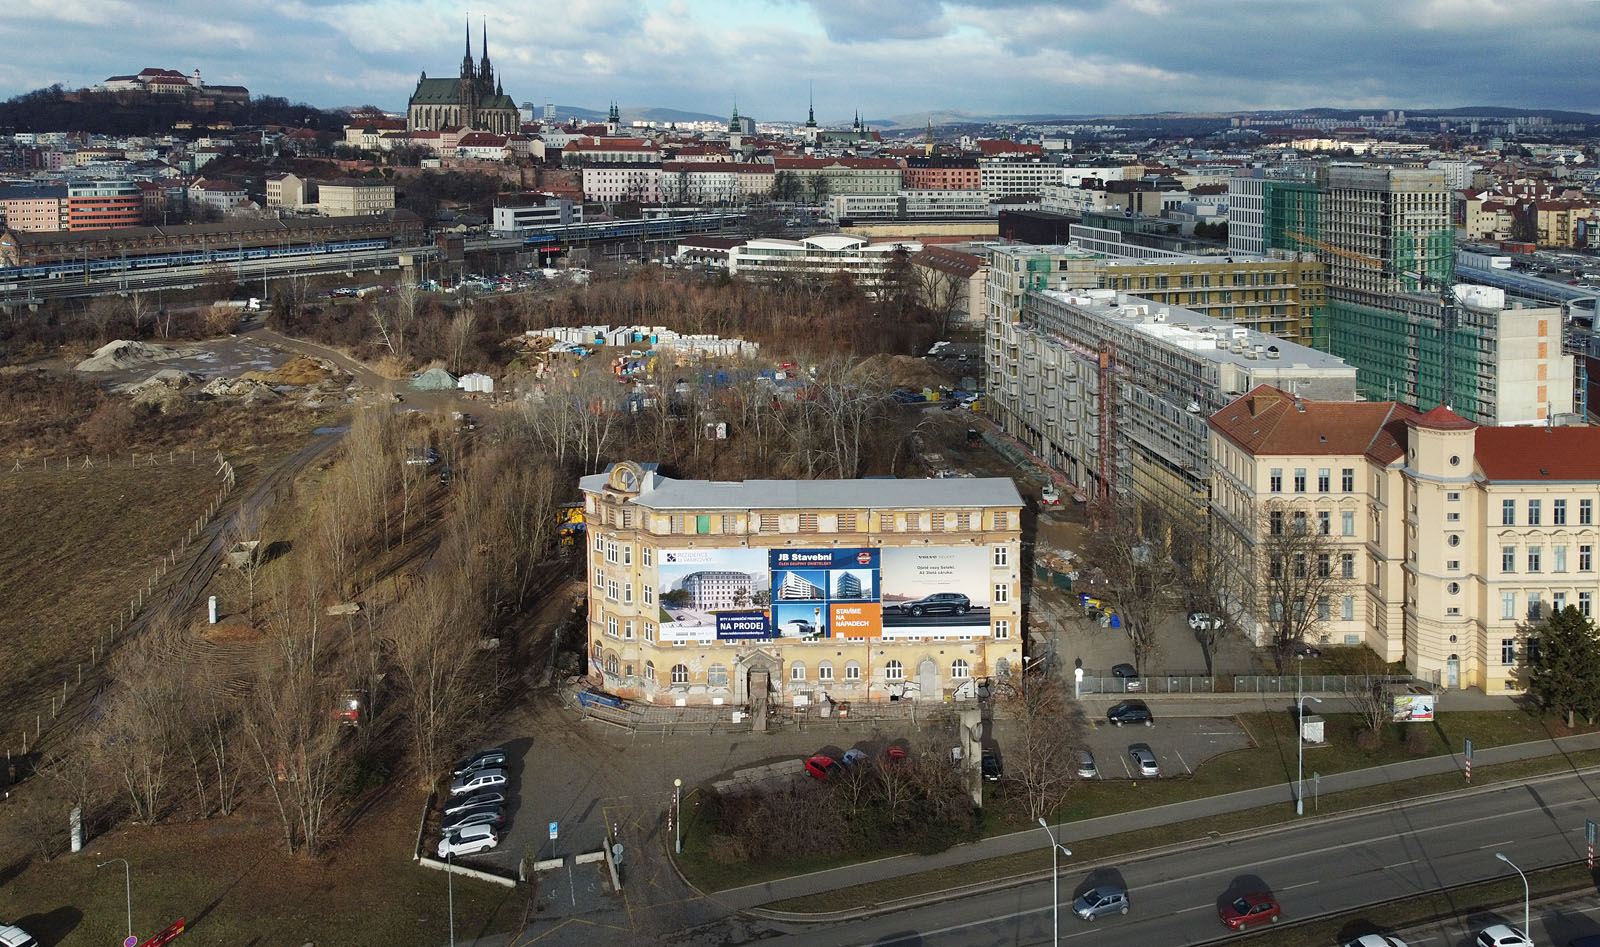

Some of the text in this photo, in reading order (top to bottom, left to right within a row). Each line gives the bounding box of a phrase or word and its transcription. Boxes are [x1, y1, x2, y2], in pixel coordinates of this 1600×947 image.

[778, 553, 832, 561] JB Stavební
[720, 622, 764, 630] NA PRODEJ
